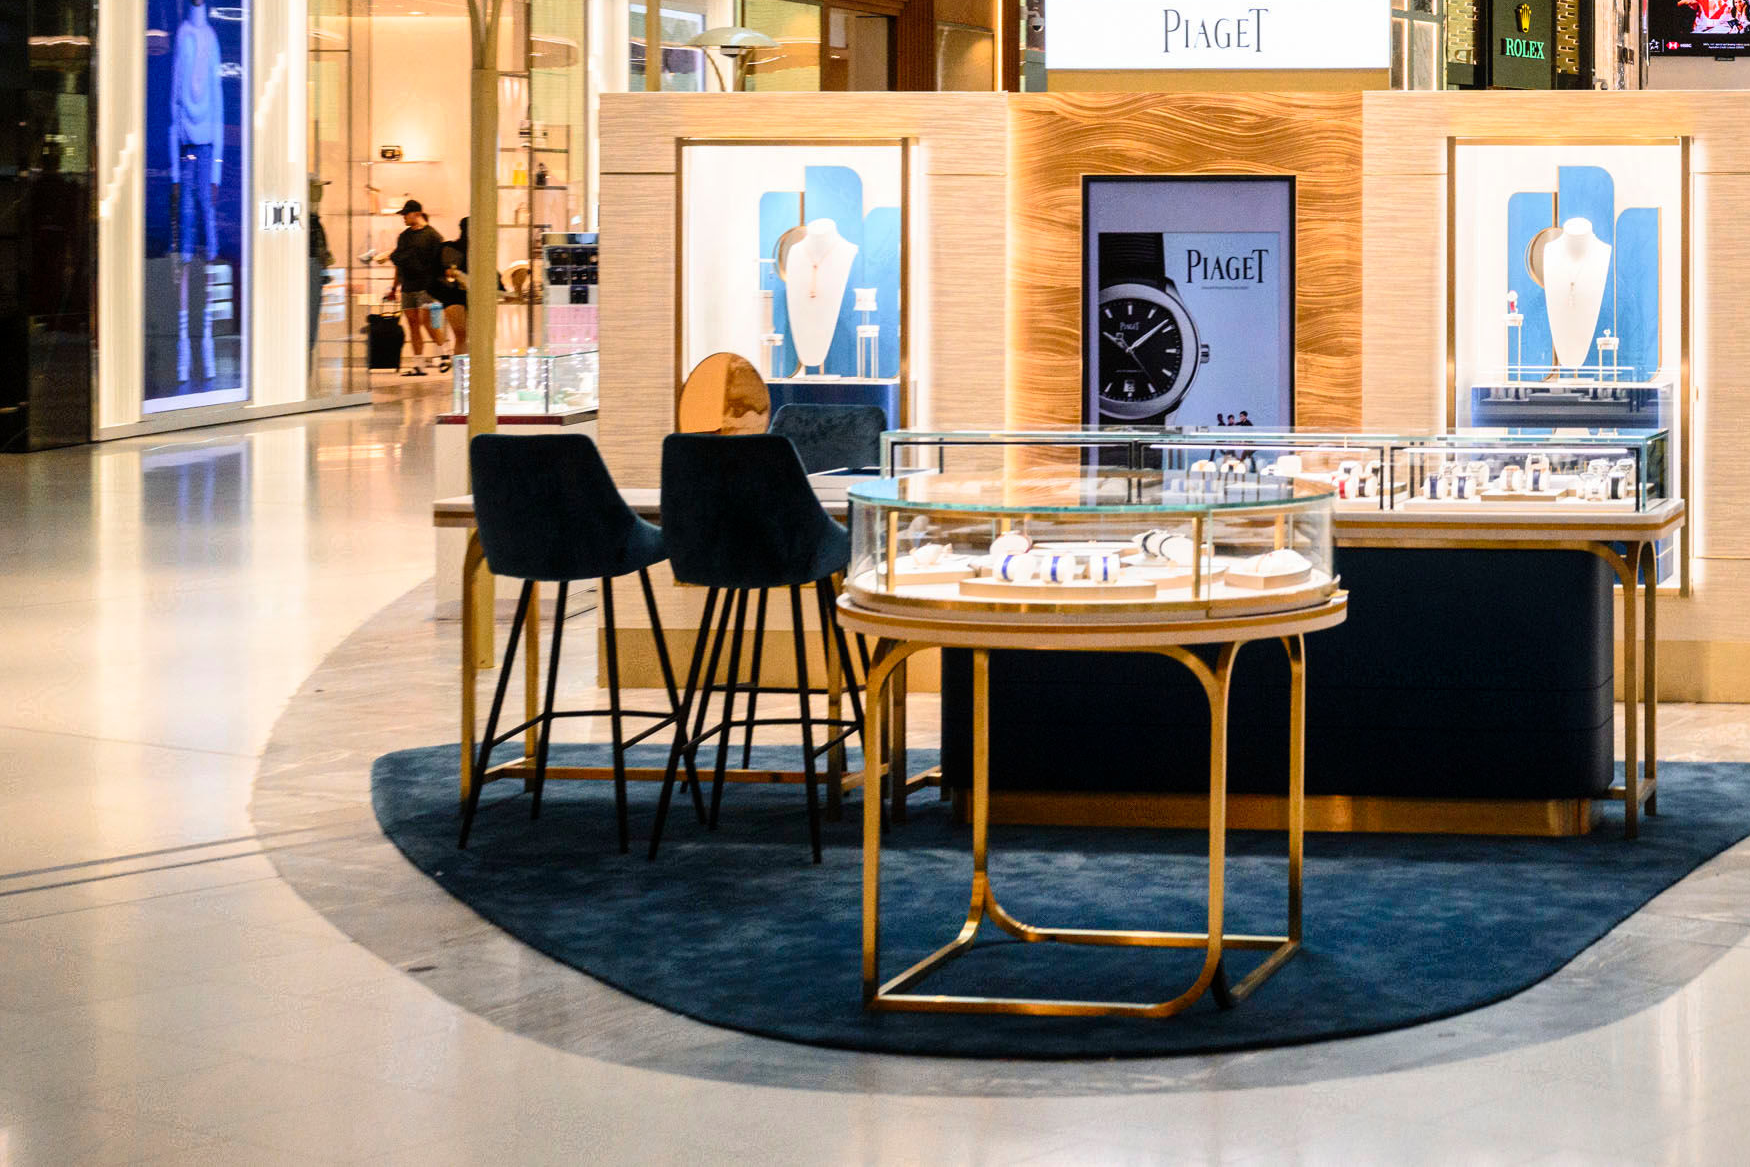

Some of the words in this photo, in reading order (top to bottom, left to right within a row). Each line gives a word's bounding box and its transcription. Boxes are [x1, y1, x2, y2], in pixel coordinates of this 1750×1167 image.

[1163, 8, 1269, 53] PIAGET
[1505, 37, 1545, 60] ROLEX
[1186, 249, 1270, 284] PIAGET
